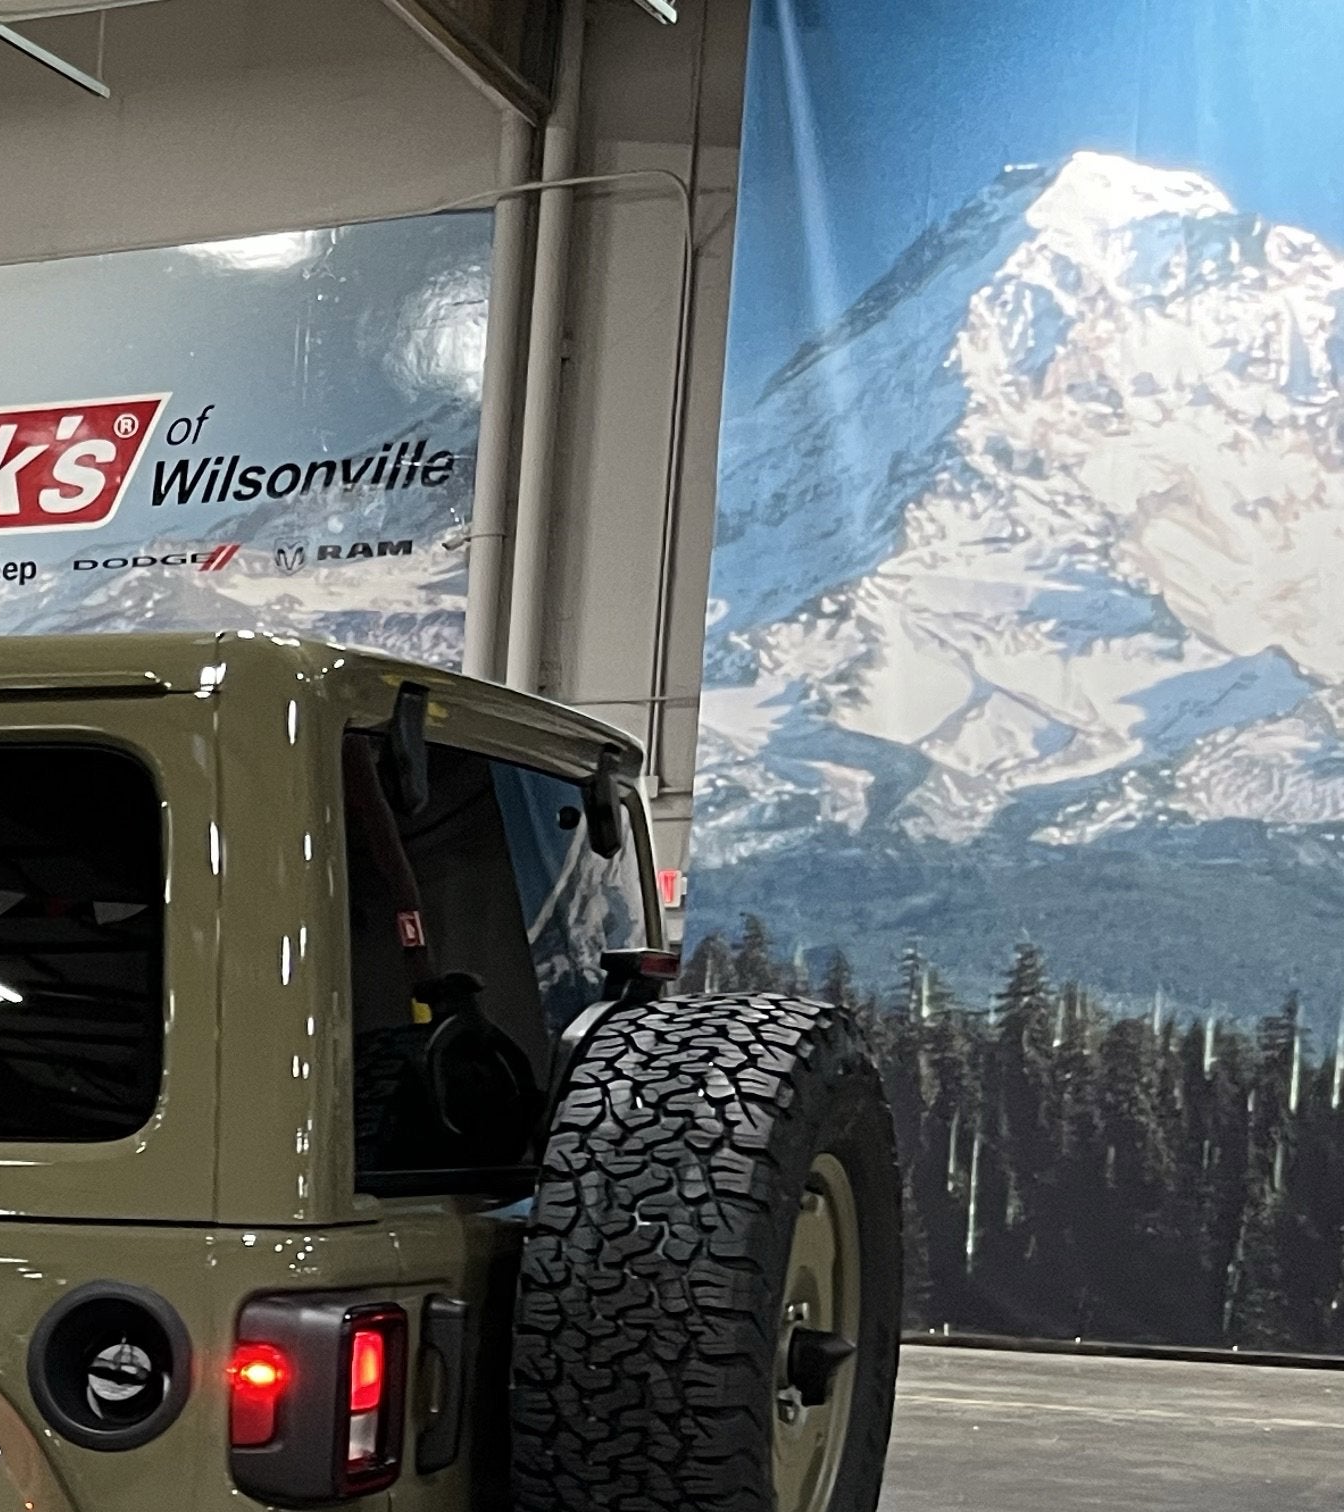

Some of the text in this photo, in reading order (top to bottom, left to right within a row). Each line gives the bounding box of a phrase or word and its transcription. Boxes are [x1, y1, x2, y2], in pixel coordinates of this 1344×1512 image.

[164, 404, 215, 446] of
[149, 439, 457, 508] Wilsonville
[72, 551, 213, 571] DODGE
[316, 540, 414, 561] RAM
